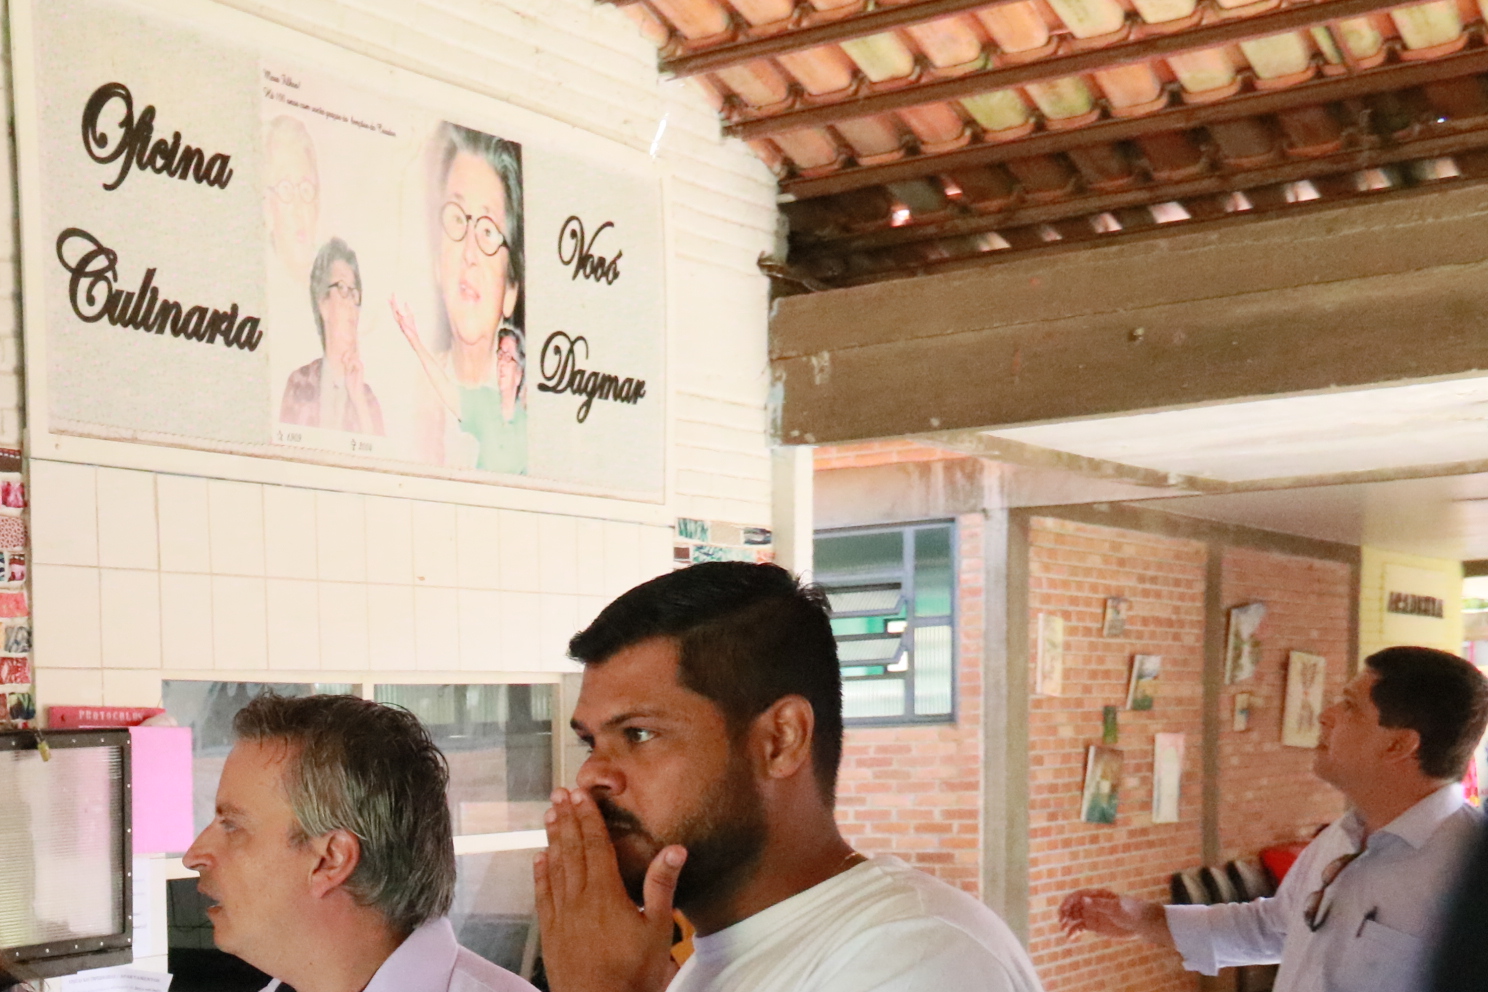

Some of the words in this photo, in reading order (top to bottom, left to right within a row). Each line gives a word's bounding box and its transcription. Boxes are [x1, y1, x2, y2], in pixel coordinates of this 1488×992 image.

[81, 81, 233, 191] Oficina
[558, 215, 623, 286] Vovó
[537, 331, 647, 424] Dagmar
